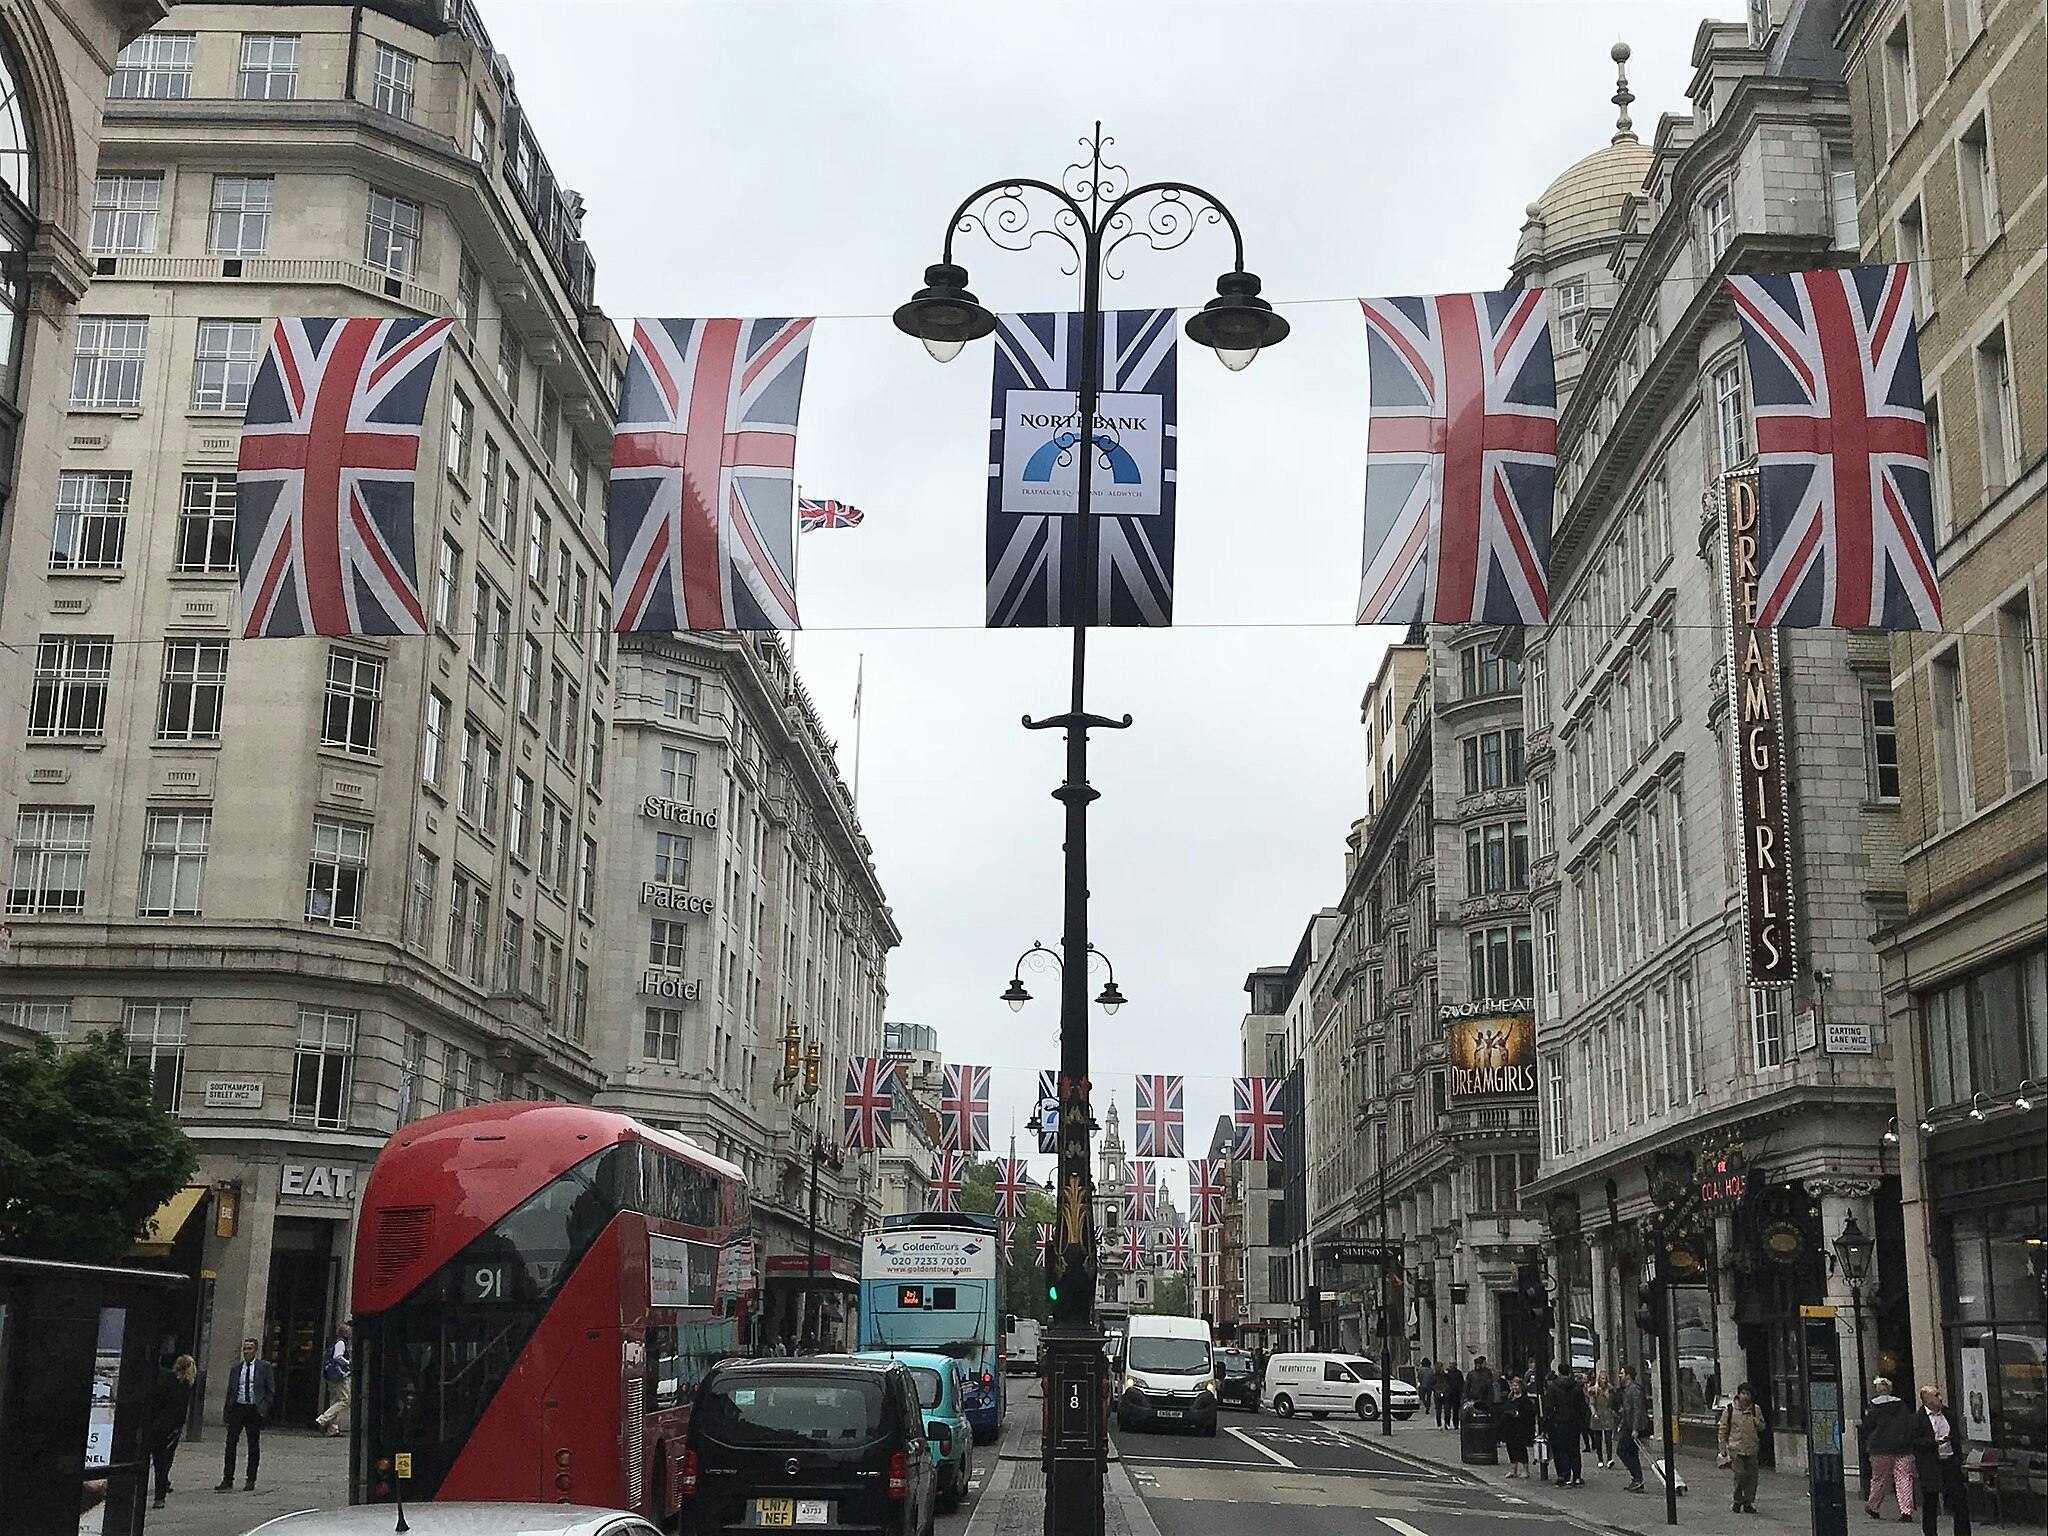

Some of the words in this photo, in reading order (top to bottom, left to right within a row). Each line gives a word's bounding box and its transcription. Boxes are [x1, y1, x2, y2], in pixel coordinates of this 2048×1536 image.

[1736, 481, 1779, 970] DREAMGIRLS
[644, 796, 719, 830] Strand
[642, 882, 715, 915] Palace
[641, 972, 702, 1001] Hotel
[1829, 1027, 1861, 1036] CARTING
[209, 1083, 260, 1091] SOUTHAMPTON
[1451, 1064, 1535, 1096] DREAMGIRLS
[209, 1091, 234, 1099] STREET
[281, 1165, 356, 1199] EAT.
[887, 1266, 972, 1274] www.goldentours.com
[891, 1257, 911, 1265] 020
[915, 1257, 938, 1265] 7233
[941, 1257, 967, 1266] 7030
[475, 1268, 502, 1298] 91
[762, 1500, 788, 1511] LN17
[765, 1512, 787, 1524] NEF
